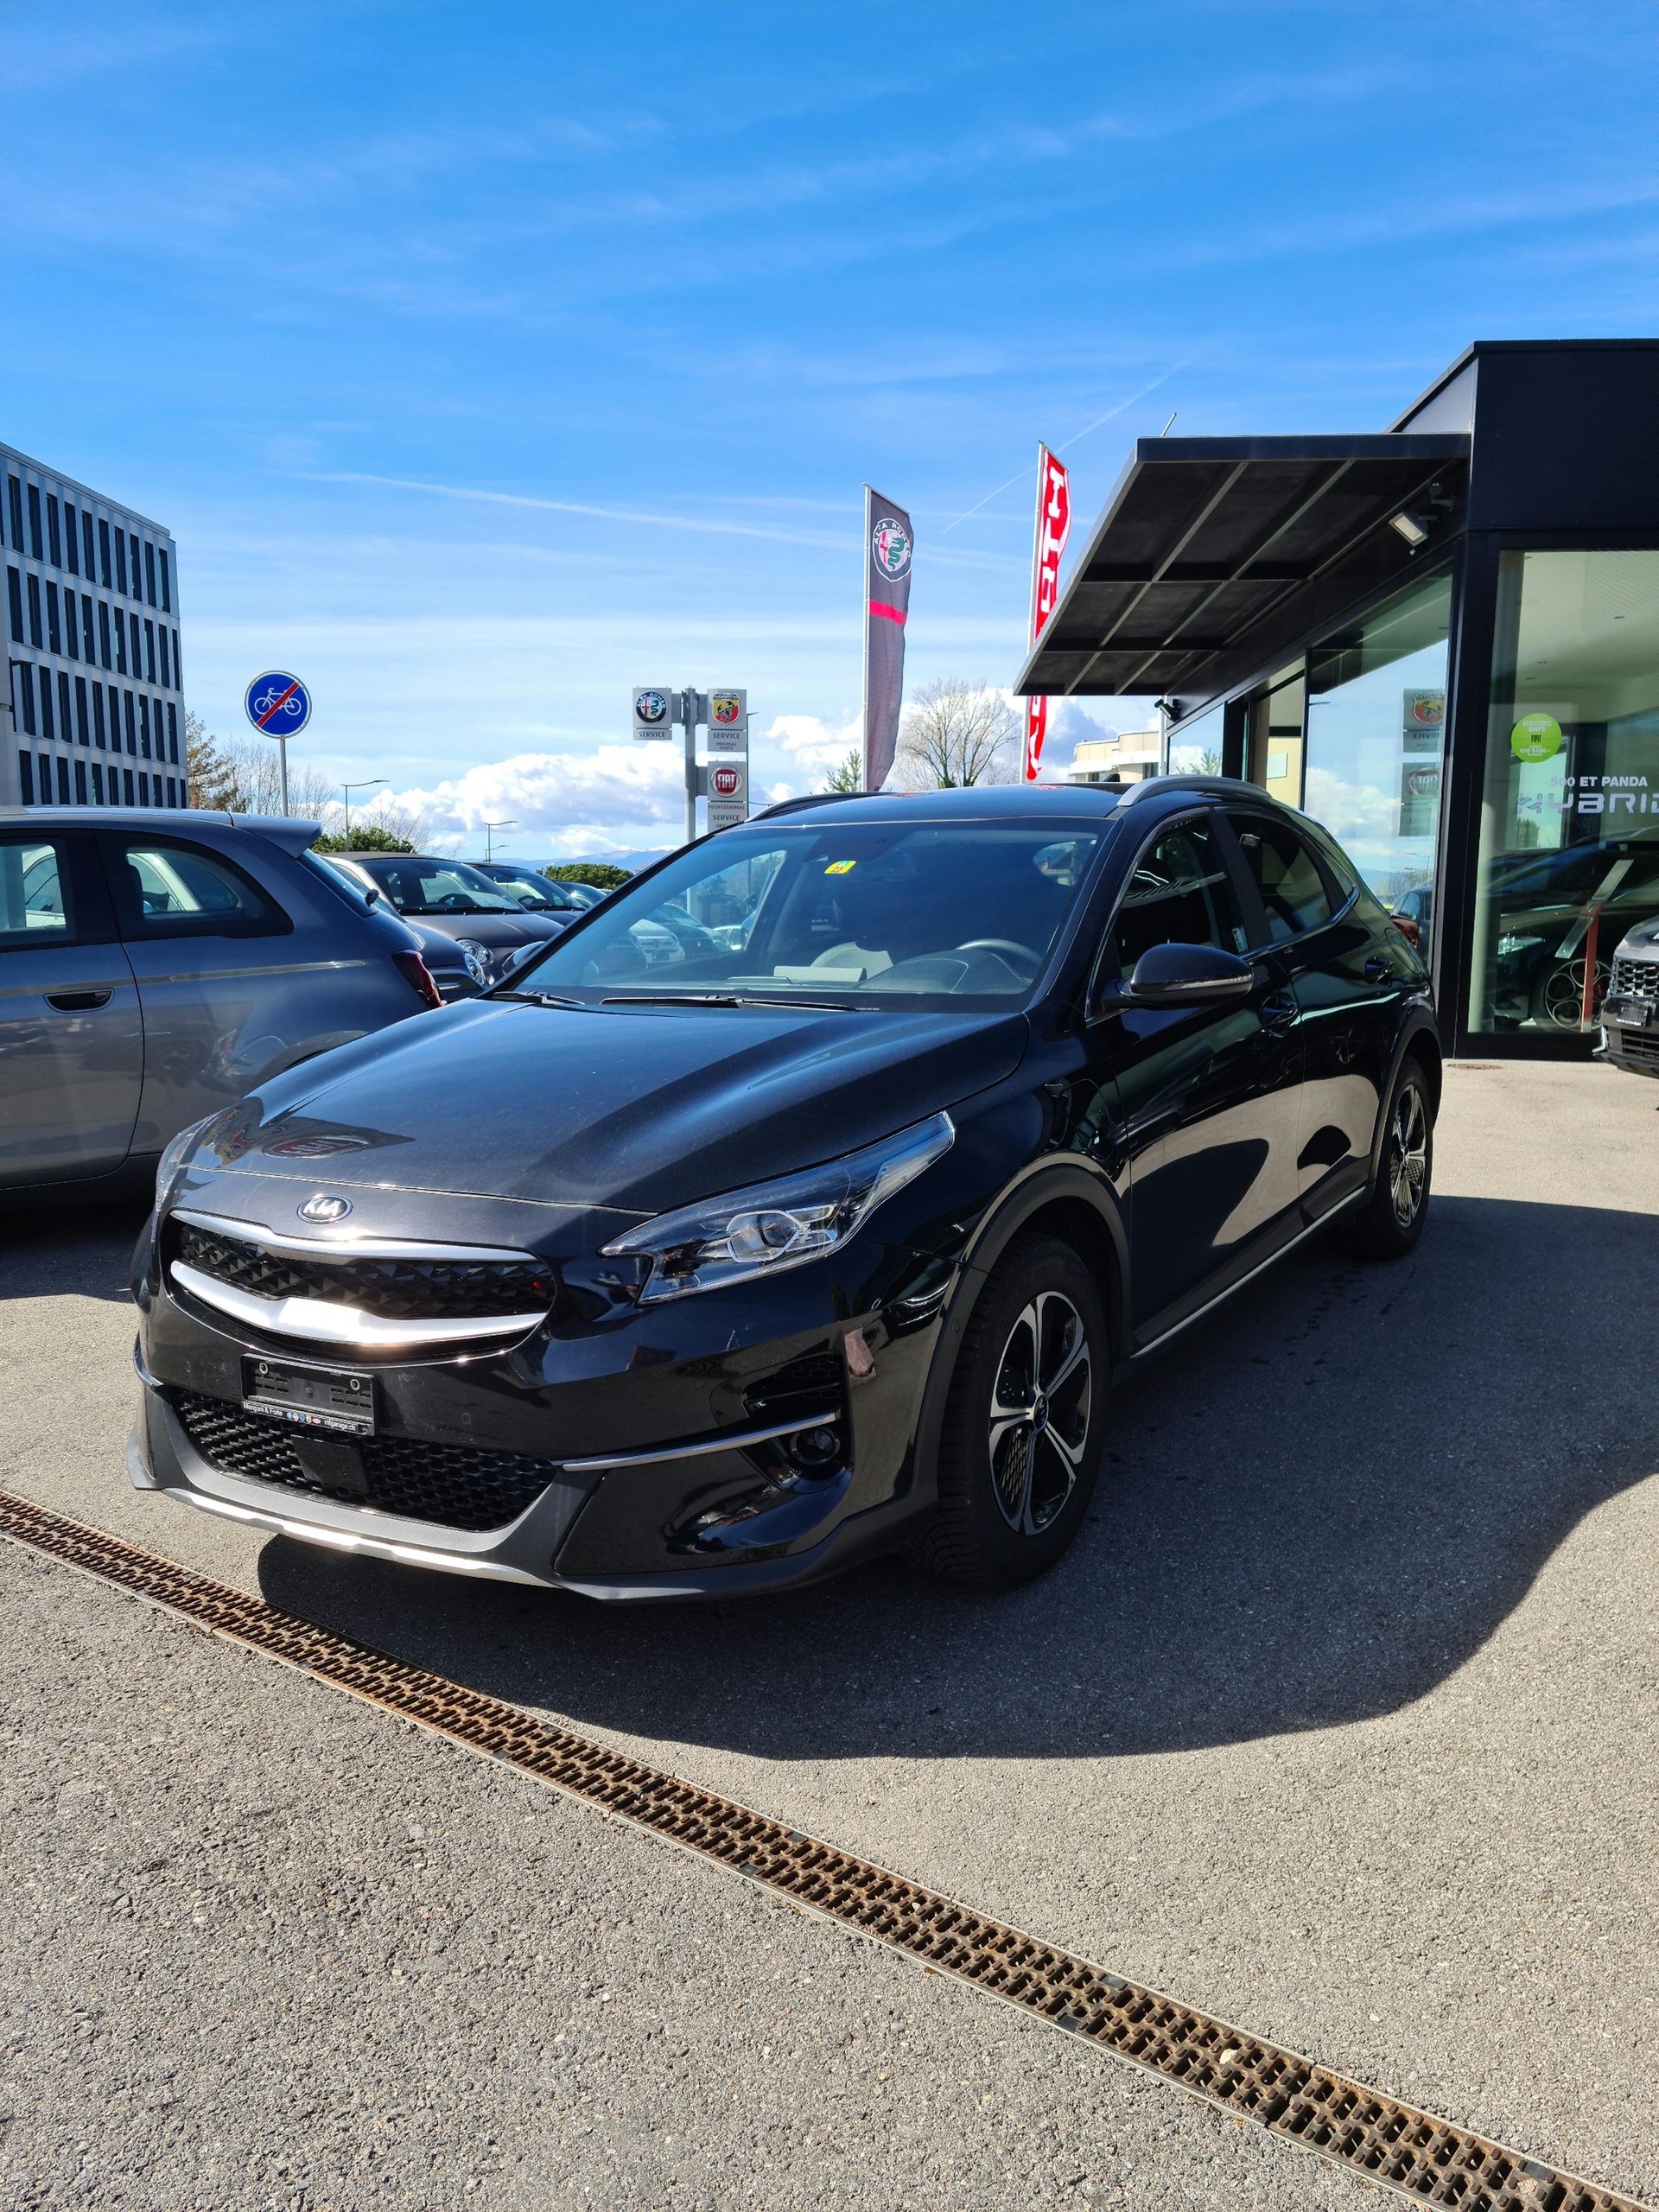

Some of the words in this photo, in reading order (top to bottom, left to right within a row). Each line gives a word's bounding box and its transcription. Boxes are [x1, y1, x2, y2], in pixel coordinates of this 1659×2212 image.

[649, 692, 666, 709] ROMEO
[1530, 734, 1542, 743] FIAT
[717, 773, 735, 788] FIAT
[1550, 776, 1575, 787] 500
[1580, 776, 1598, 787] ET
[1601, 776, 1649, 787] PANDA
[302, 1198, 341, 1217] KIA
